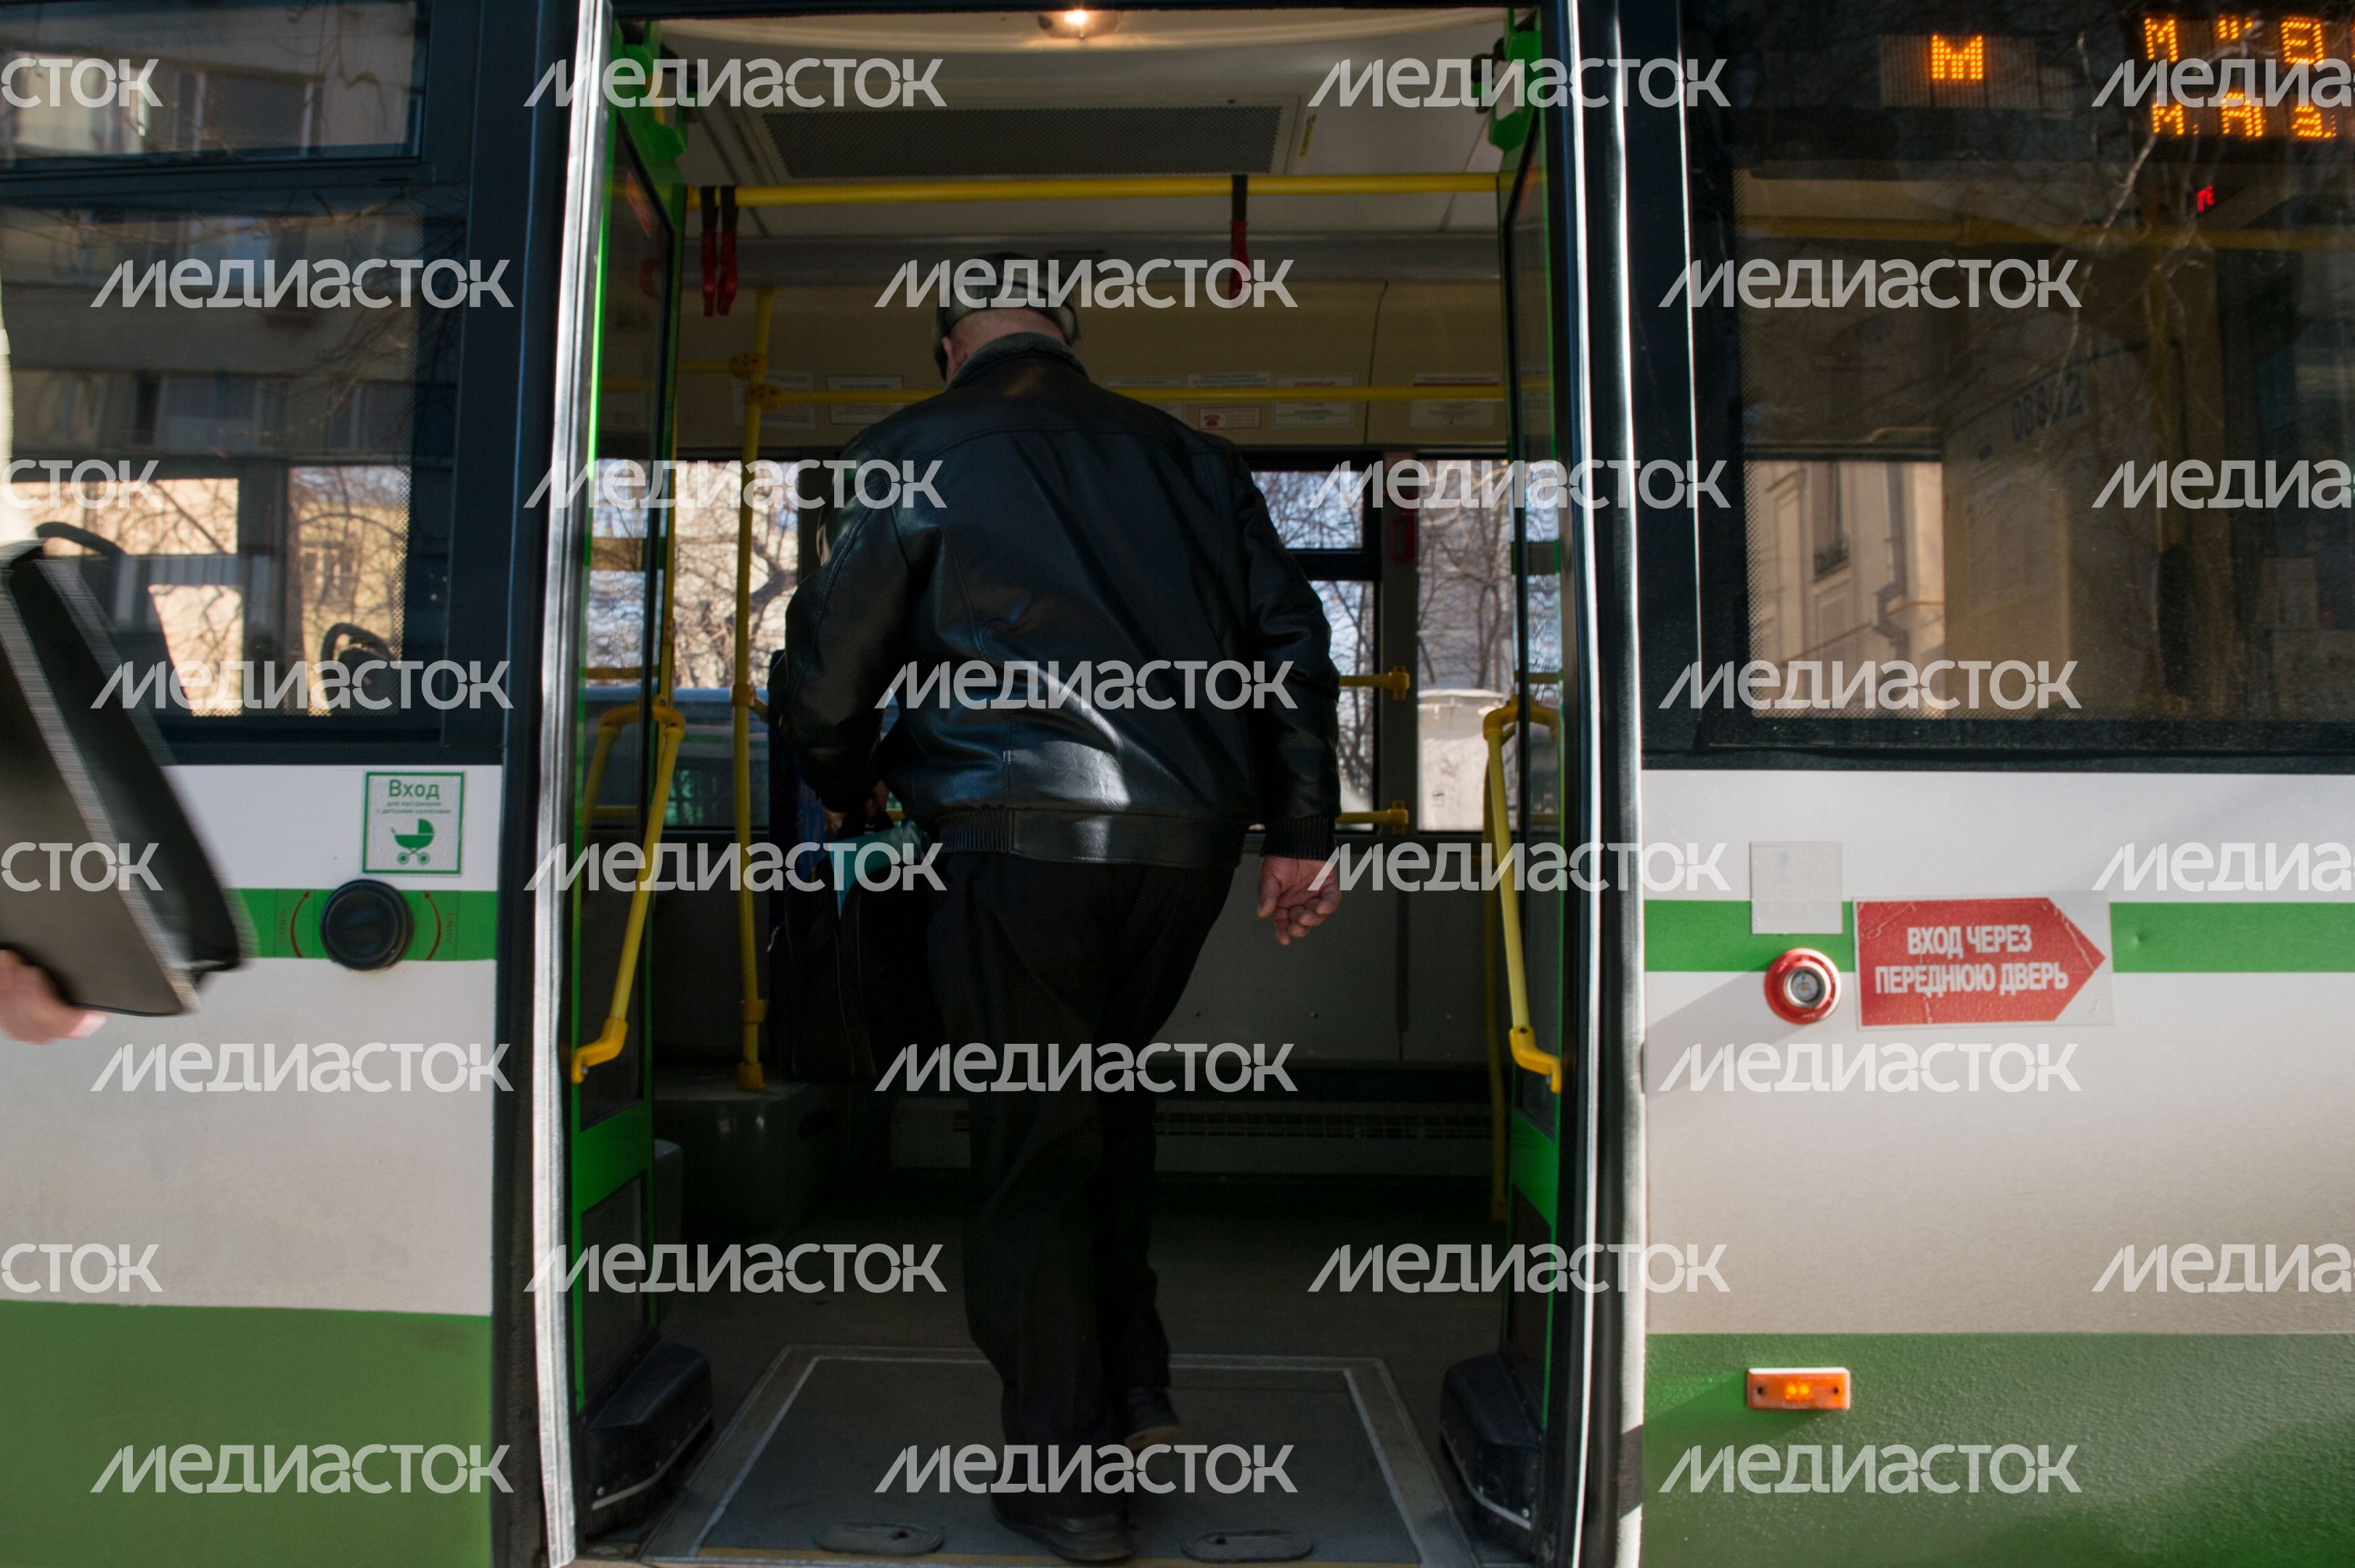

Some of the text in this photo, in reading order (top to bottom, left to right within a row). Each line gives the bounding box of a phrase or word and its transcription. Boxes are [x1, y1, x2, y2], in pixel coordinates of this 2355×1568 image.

[388, 779, 439, 800] Вход
[1907, 924, 2033, 959] ВХОД ЧЕРЕЗ
[1875, 961, 2069, 998] ПЕРЕДНЮЮ ДВЕРЬ
